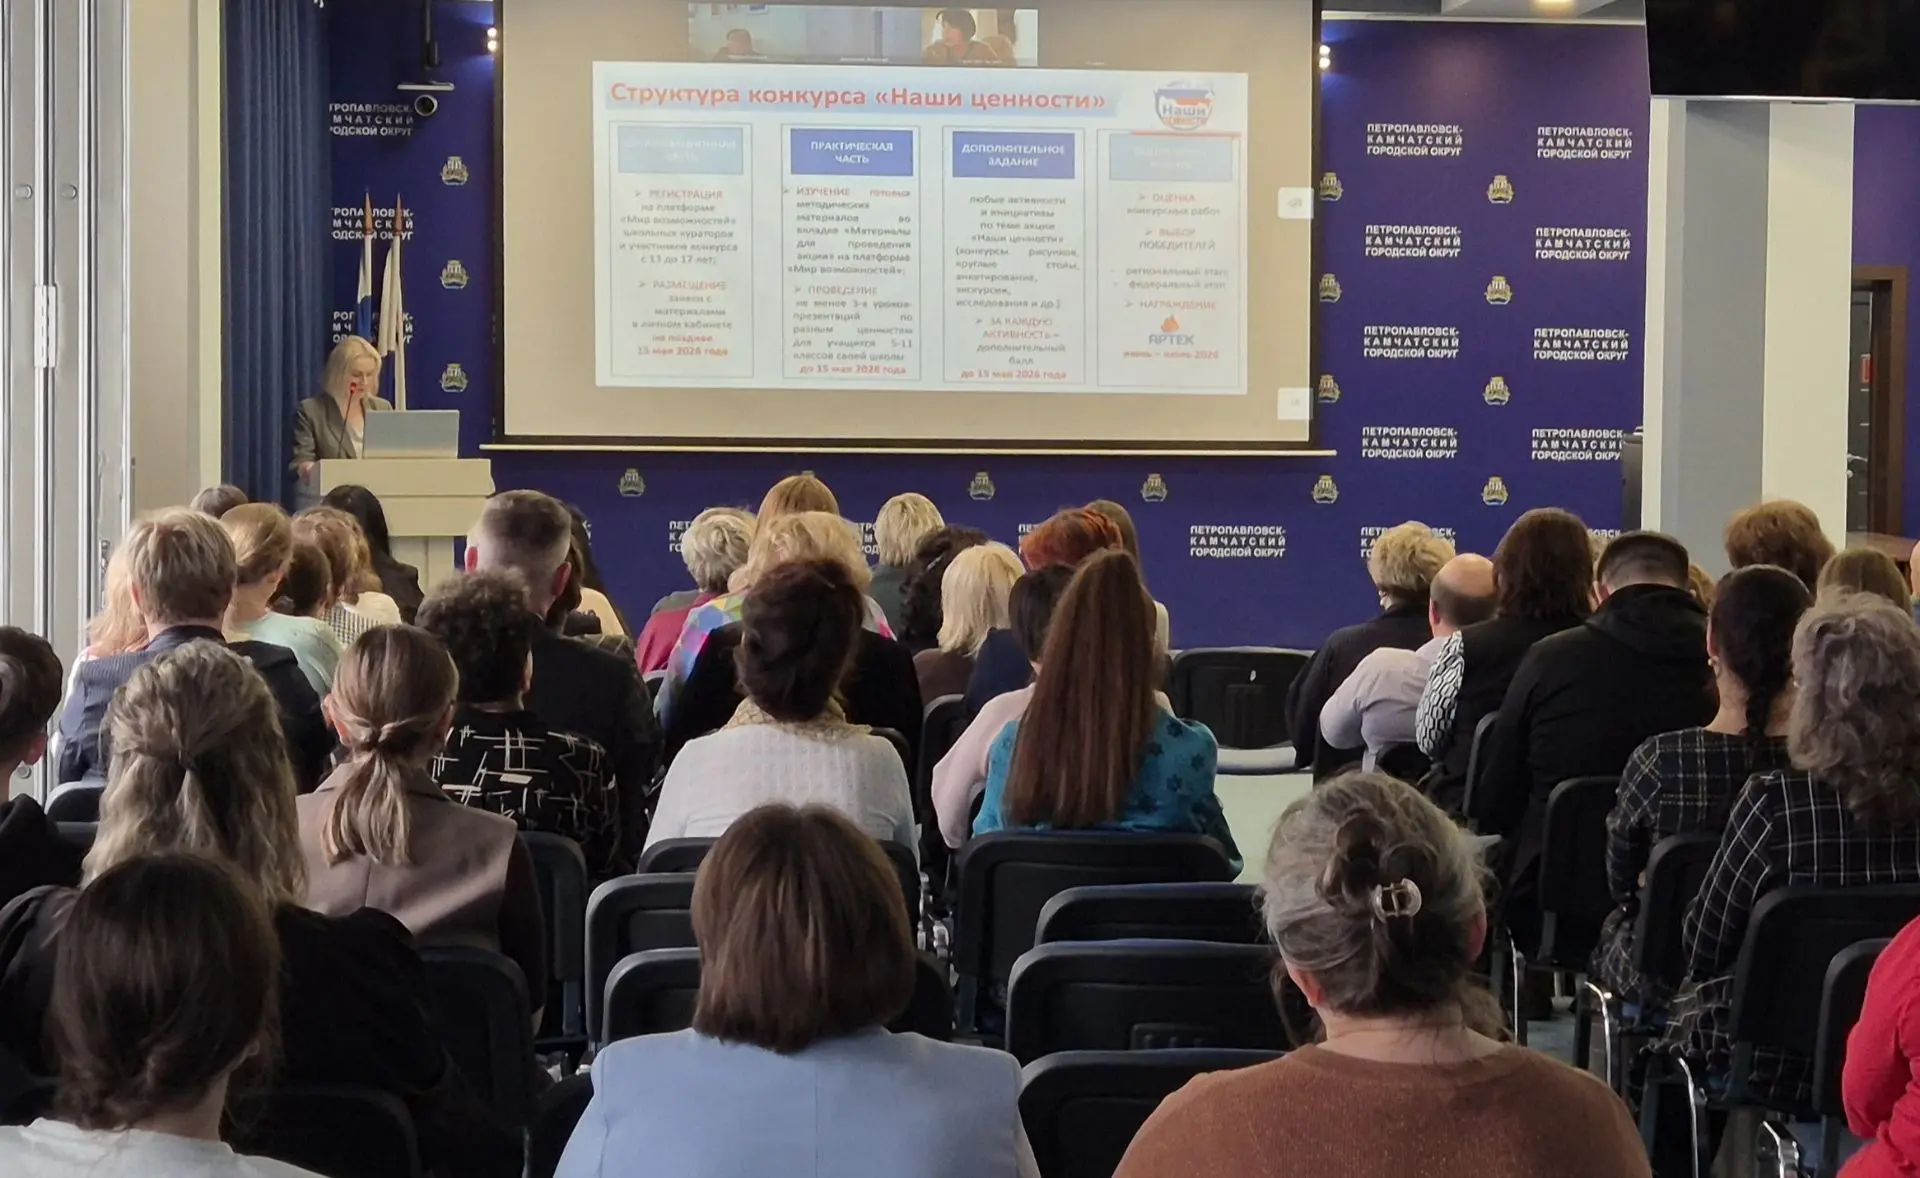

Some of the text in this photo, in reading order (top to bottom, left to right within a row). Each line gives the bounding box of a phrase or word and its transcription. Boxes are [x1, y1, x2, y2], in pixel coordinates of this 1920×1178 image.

[610, 82, 1106, 111] Структура конкурса «Наши ценности»
[1162, 104, 1206, 116] Наши
[332, 114, 414, 124] МЧАТСКИЙ
[330, 126, 412, 136] ОДСКОЙ ОКРУГ
[1366, 124, 1462, 134] ПЕТРОПАВЛОВСК-
[1537, 127, 1633, 138] ПЕТРОПАВЛОВСК-
[1366, 134, 1462, 145] КАМЧАТСКИЙ
[1537, 138, 1632, 148] КАМЧАТСКИЙ
[810, 140, 894, 152] ПРАКТИЧЕСКАЯ
[960, 142, 1065, 156] ДОПОЛНИТЕЛЬНОЕ
[1366, 144, 1462, 156] ГОРОДСКОЙ ОКРУГ
[834, 154, 870, 164] ЧАСТЬ
[1537, 148, 1632, 160] ГОРОДСКОЙ ОКРУГ
[988, 156, 1039, 168] ЗАДАНИЕ
[649, 190, 724, 200] РЕГИСТРАЦИЯ
[796, 186, 850, 196] ИЗУЧЕНИЕ
[1152, 193, 1196, 203] ОЦЕНКА
[334, 207, 414, 218] РОПАЛОВК-
[332, 218, 414, 229] МЧАСКЙ
[380, 230, 414, 240] ОКУГ
[1365, 225, 1461, 236] ПЕТРОПАВЛОВСК-
[1535, 228, 1631, 238] ПЕТРОПАВЛОВСК-
[1139, 239, 1216, 250] ПОБЕДИТЕЛЕЙ
[1365, 236, 1460, 246] КАМЧАТСКИЙ
[1535, 238, 1630, 250] КАМЧАТСКИЙ
[1365, 246, 1460, 258] ГОРОДСКОЙ ОКРУГ
[1535, 248, 1630, 260] ГОРОДСКОЙ ОКРУГ
[652, 280, 728, 290] РАЗМЕЩЕНИЕ
[808, 286, 878, 296] ПРОВЕДЕНИЕ
[1140, 300, 1216, 310] НАГРАЖДЕНИЕ
[982, 330, 1051, 340] АКТИВНОСТЬ
[1364, 326, 1460, 336] ПЕТРОПАВЛОВСК-
[1534, 328, 1630, 339] ПЕТРОПАВЛОВСК-
[1148, 334, 1194, 346] АРТЕК
[1364, 336, 1459, 348] КАМЧАТСКИЙ
[1534, 339, 1629, 350] КАМЧАТСКИЙ
[1364, 346, 1458, 358] ГОРОДСКОЙ ОКРУГ
[1534, 349, 1628, 361] ГОРОДСКОЙ ОКРУГ
[1008, 356, 1034, 365] балл
[1362, 427, 1458, 438] ПЕТРОПАВЛОВСК-
[1362, 438, 1457, 448] КАМЧАТСКИЙ
[1362, 448, 1456, 460] ГОРОДСКОЙ ОКРУГ
[1532, 449, 1621, 461] ГОРОДСКОЙ ОКРУ
[1190, 526, 1286, 536] ПЕТРОПАВЛОВСК-
[1190, 536, 1286, 547] КАМЧАТСКИЙ
[1190, 546, 1285, 558] ГОРОДСКОЙ ОКРУГ
